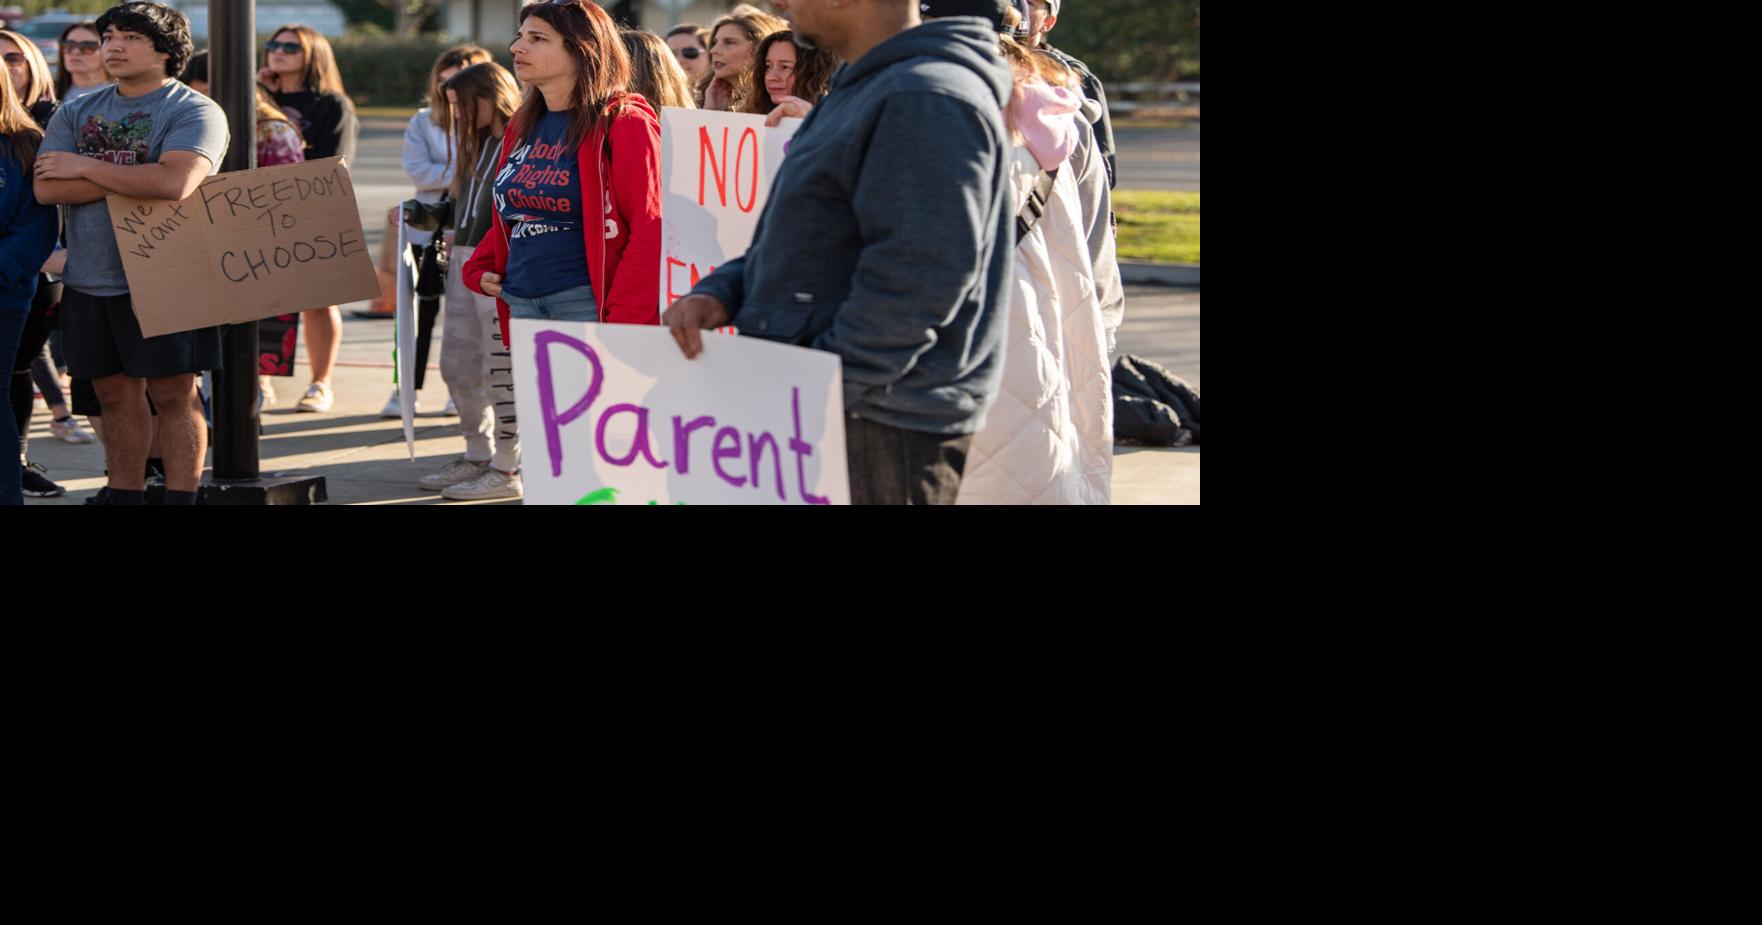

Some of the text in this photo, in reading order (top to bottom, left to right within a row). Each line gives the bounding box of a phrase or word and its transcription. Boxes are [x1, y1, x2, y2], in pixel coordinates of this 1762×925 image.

[198, 168, 349, 225] FREEDOM
[511, 162, 571, 189] Rights
[698, 126, 759, 213] NO
[116, 203, 154, 235] We
[507, 187, 572, 213] Choice
[220, 228, 362, 283] CHOOSE
[534, 329, 831, 505] Parent
